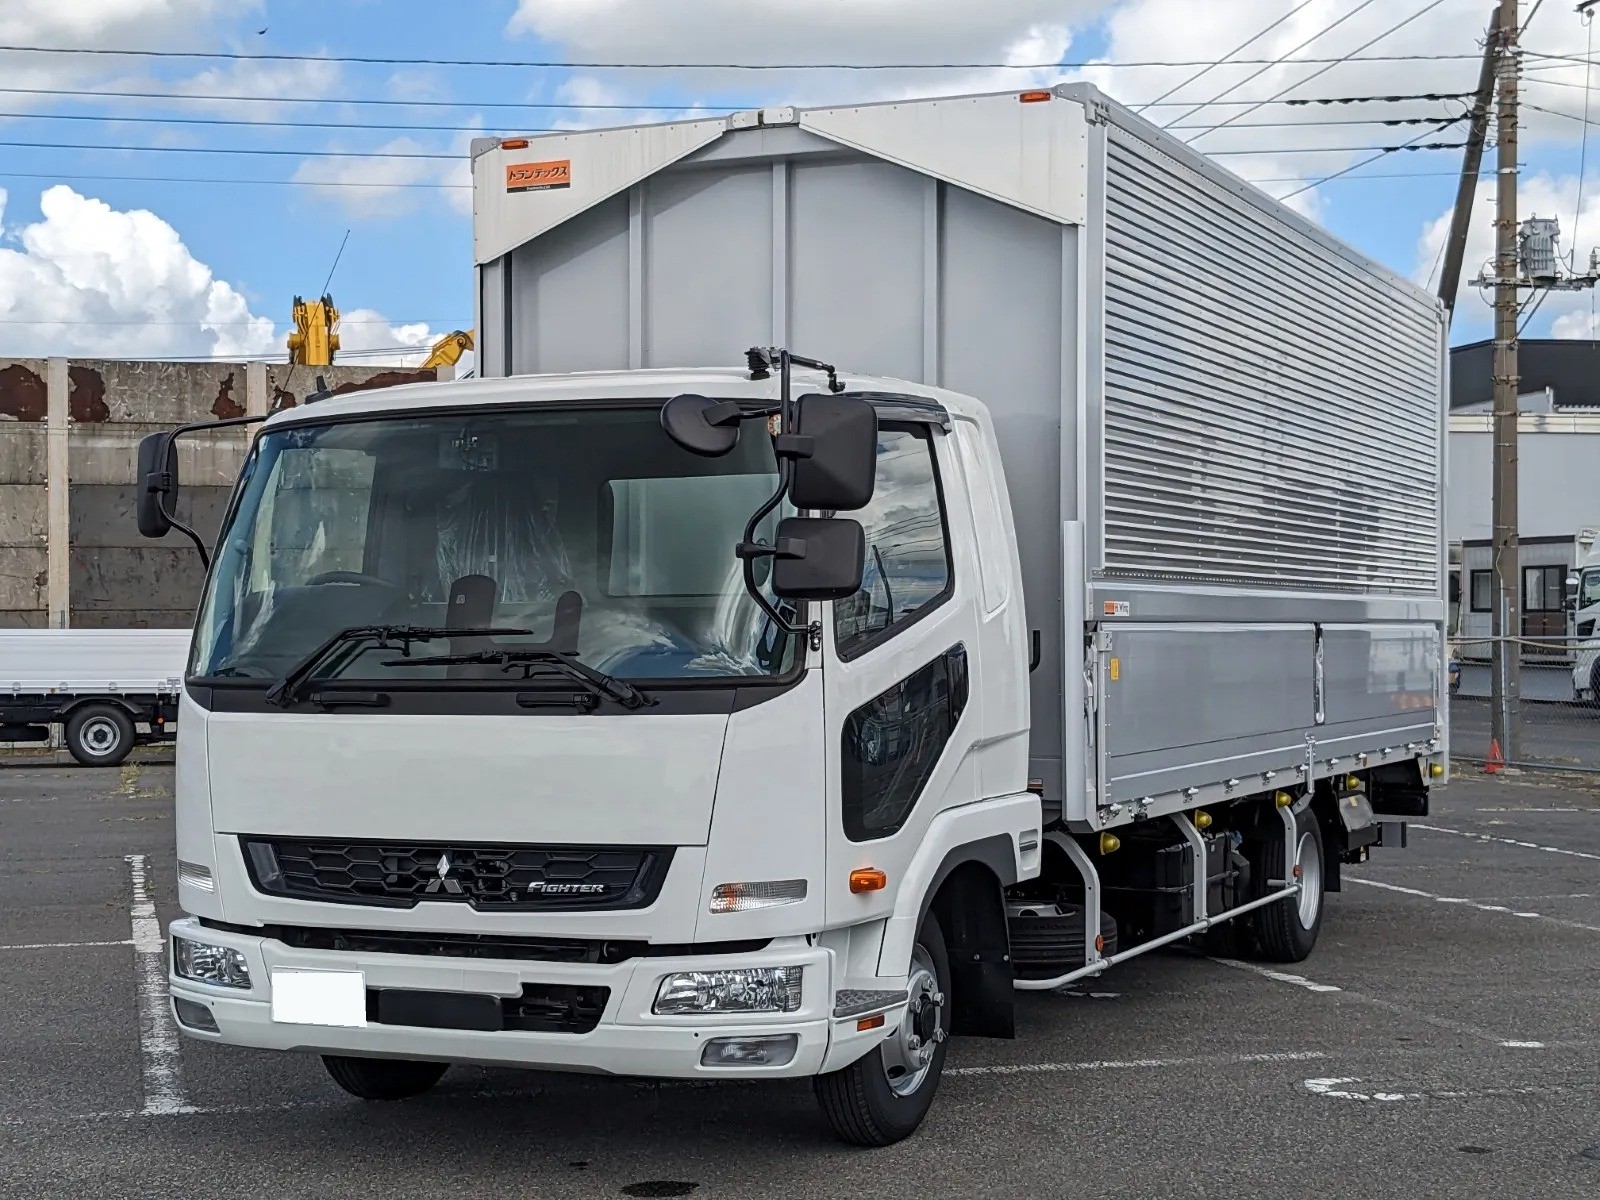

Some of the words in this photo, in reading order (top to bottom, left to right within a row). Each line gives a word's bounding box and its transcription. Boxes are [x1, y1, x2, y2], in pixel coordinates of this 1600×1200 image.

[509, 166, 567, 181] トランテックス
